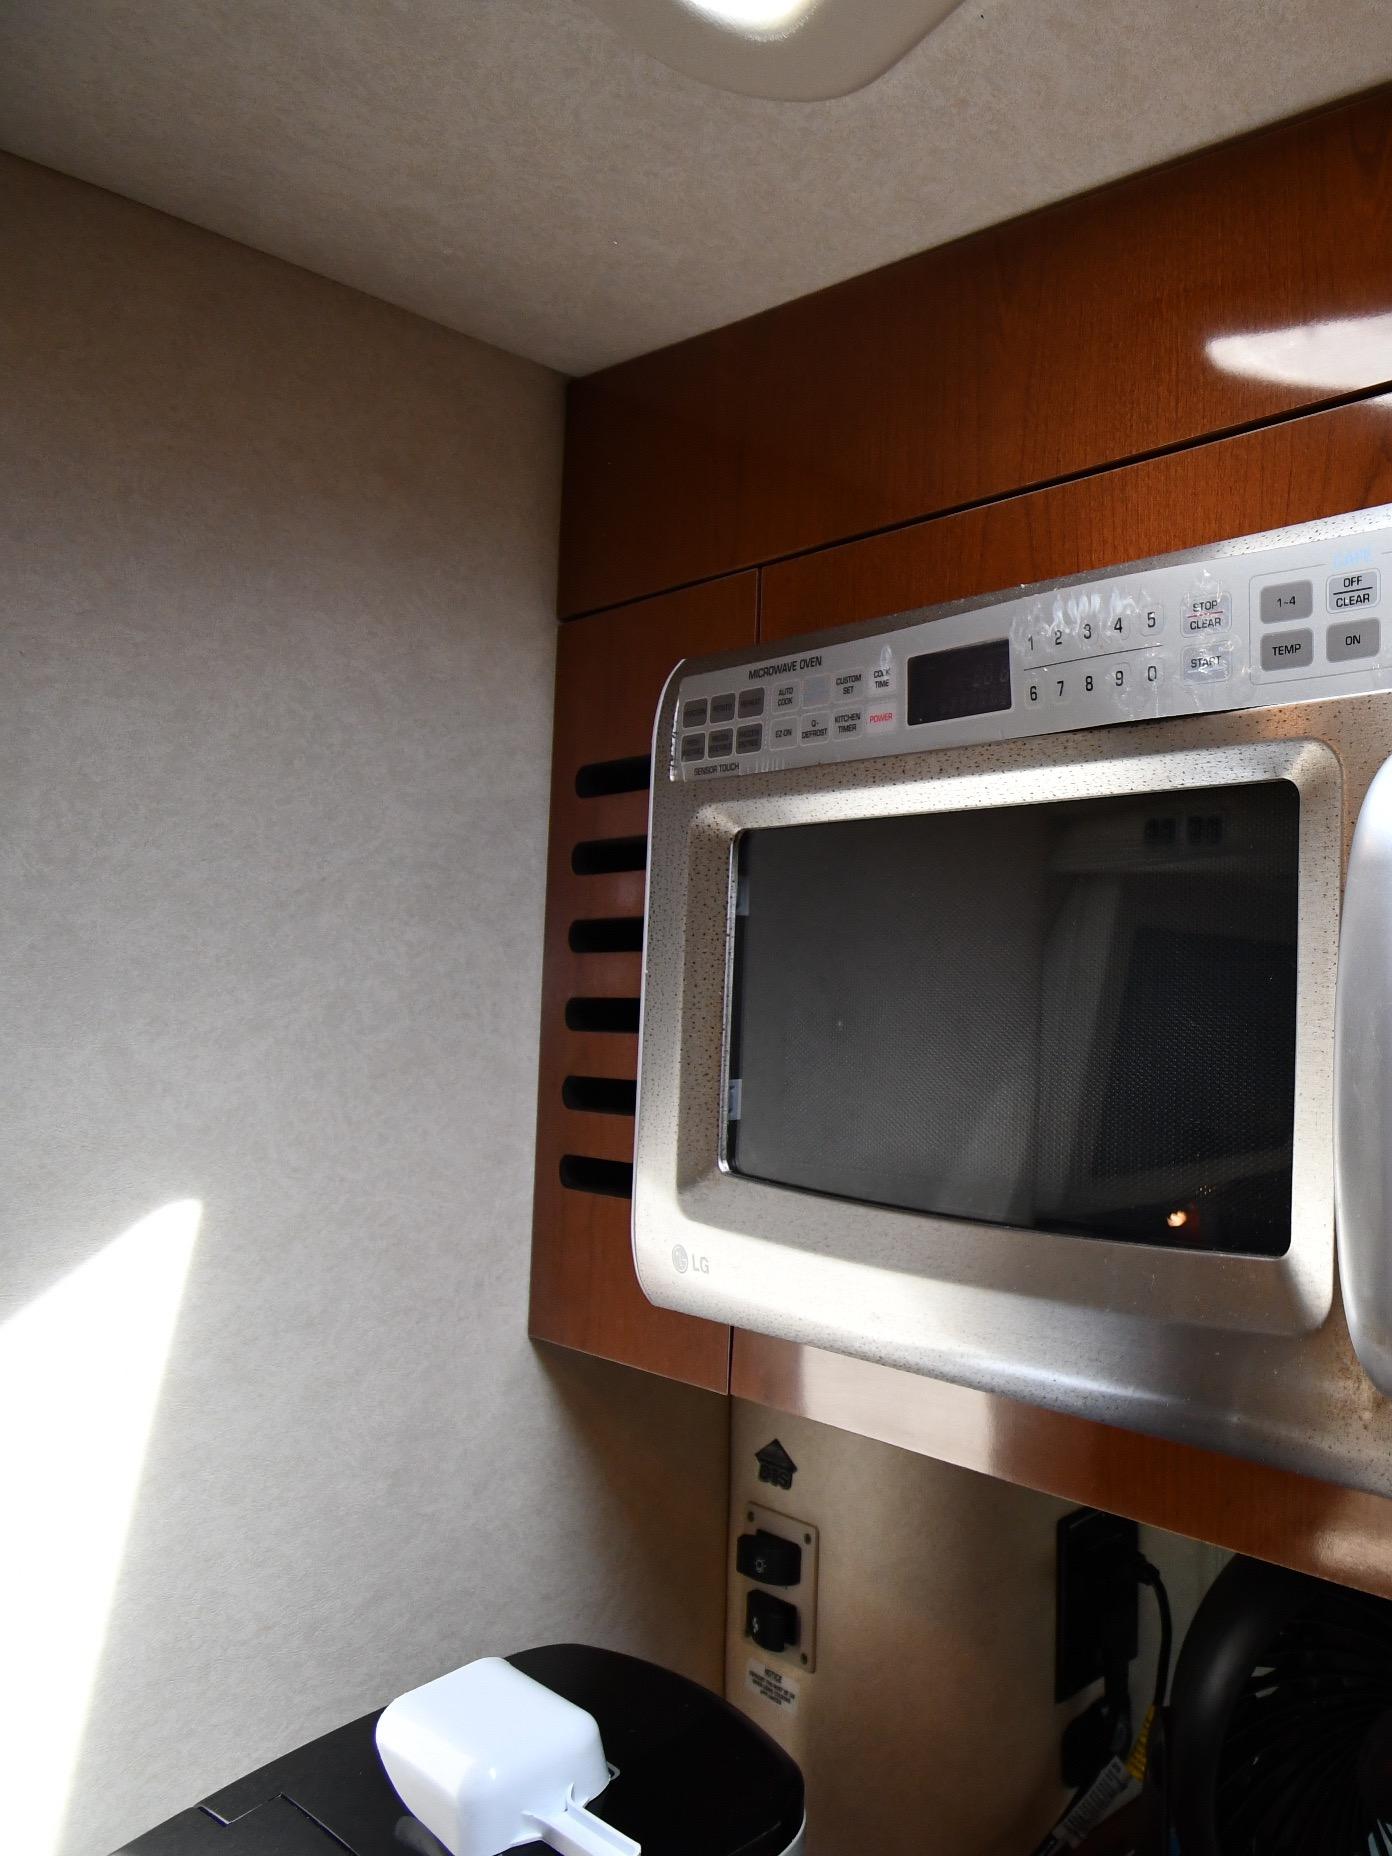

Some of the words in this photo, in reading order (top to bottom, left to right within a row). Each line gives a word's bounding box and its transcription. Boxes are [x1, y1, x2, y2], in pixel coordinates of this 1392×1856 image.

[1343, 575, 1363, 588] OFF
[1192, 600, 1218, 613] STOP
[1335, 593, 1370, 608] CLEAR
[1189, 617, 1222, 630] CLEAR
[1027, 635, 1034, 651] 1
[1054, 629, 1063, 646] 2
[1083, 623, 1092, 640] 3
[1113, 617, 1123, 633] 4
[1147, 611, 1156, 628] 5
[1345, 634, 1361, 646] ON
[1272, 643, 1302, 656] TEMP
[748, 660, 798, 680] MICROWAVE
[799, 655, 822, 670] OVEN
[1190, 655, 1222, 669] START
[873, 668, 891, 679] COK
[835, 674, 862, 686] CUSTOM
[875, 679, 890, 689] TIME
[1029, 685, 1038, 701] 6
[1056, 680, 1064, 697] 7
[1085, 675, 1094, 692] 8
[1115, 670, 1124, 687] 9
[1147, 665, 1157, 682] 0
[778, 687, 793, 696] AUTO
[842, 685, 854, 695] SET
[834, 712, 861, 723] KITCHEN
[869, 712, 893, 723] POWER
[801, 727, 828, 739] DEFROST
[838, 723, 857, 733] TIMER
[719, 762, 740, 772] TOUCH
[691, 1253, 710, 1275] LG
